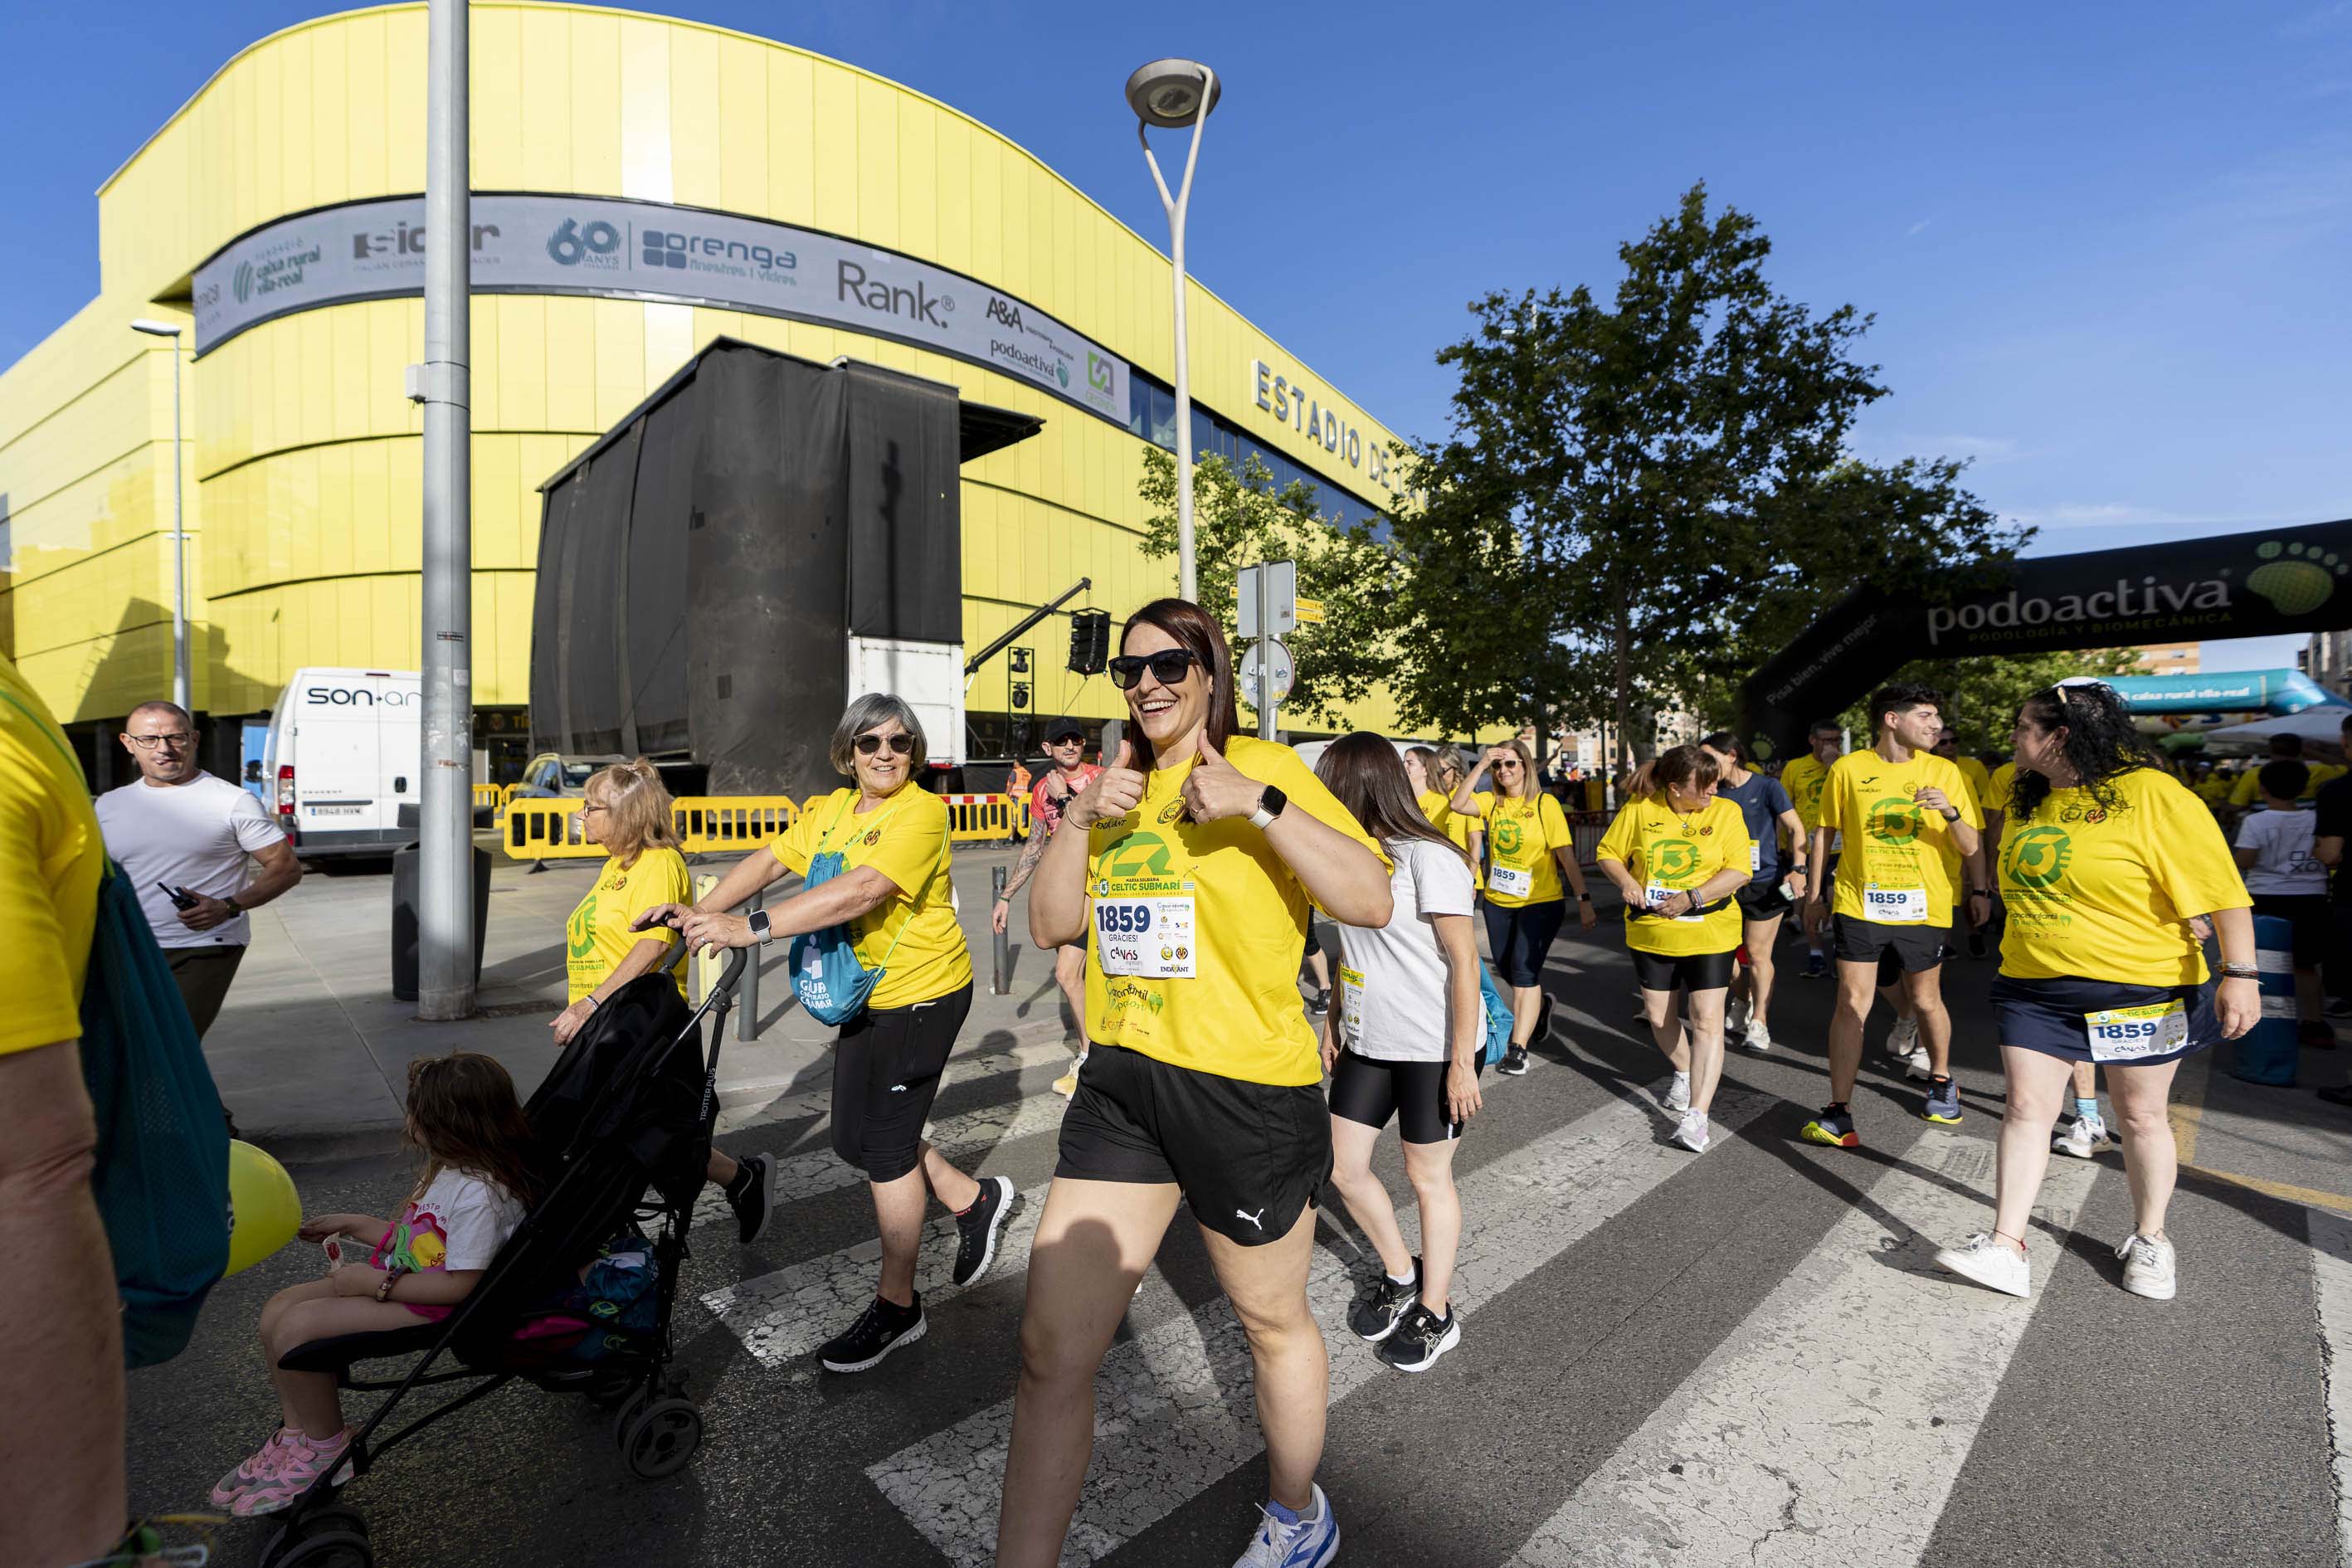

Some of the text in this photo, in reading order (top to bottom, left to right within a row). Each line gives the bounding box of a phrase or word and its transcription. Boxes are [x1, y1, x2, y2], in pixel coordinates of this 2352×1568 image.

[665, 233, 796, 269] orenga
[986, 296, 1024, 334] A&A
[991, 338, 1055, 377] podoactiva
[1250, 358, 1360, 470] ESTADIO
[1369, 441, 1390, 489] DE
[1926, 577, 2232, 646] podoactiva
[1968, 611, 2233, 644] PODOLOGÍA Y BIOMECÁNICA
[1820, 641, 1844, 665] vive
[1843, 613, 1878, 646] mejor
[1112, 879, 1180, 892] CELTIC SUBMARÍ
[1493, 867, 1516, 881] 1859
[1867, 893, 1907, 904] 1859
[1097, 905, 1151, 933] 1859
[1108, 933, 1138, 942] GRÀCIES!
[1110, 947, 1138, 961] CANÓS
[2094, 1022, 2158, 1039] 1859
[699, 1068, 716, 1122] TROTTER PLUS
